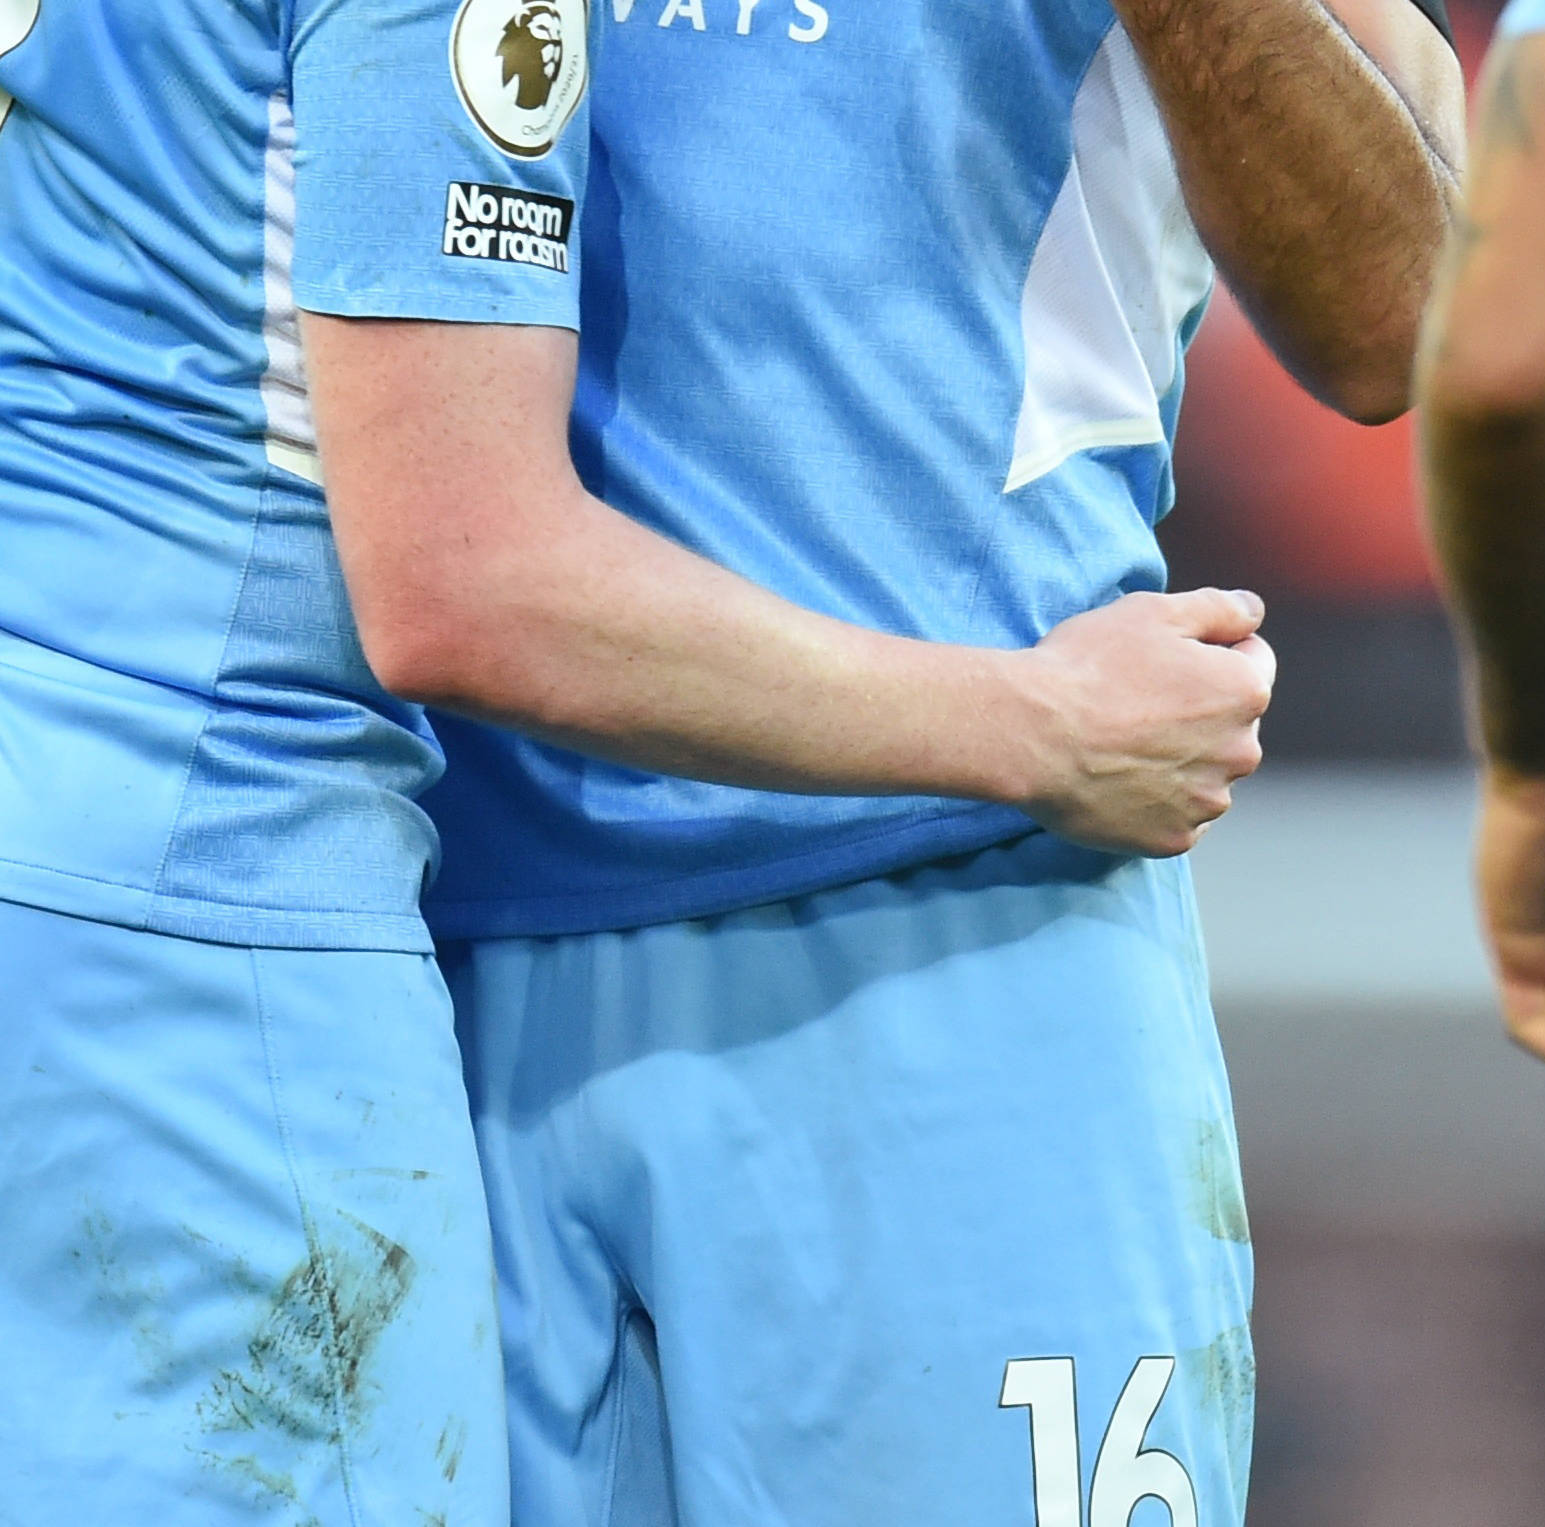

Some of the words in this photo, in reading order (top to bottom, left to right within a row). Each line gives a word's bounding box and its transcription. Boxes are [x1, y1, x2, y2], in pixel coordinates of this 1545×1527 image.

[447, 183, 498, 224] No
[501, 196, 562, 237] room
[998, 1356, 1199, 1527] 16
